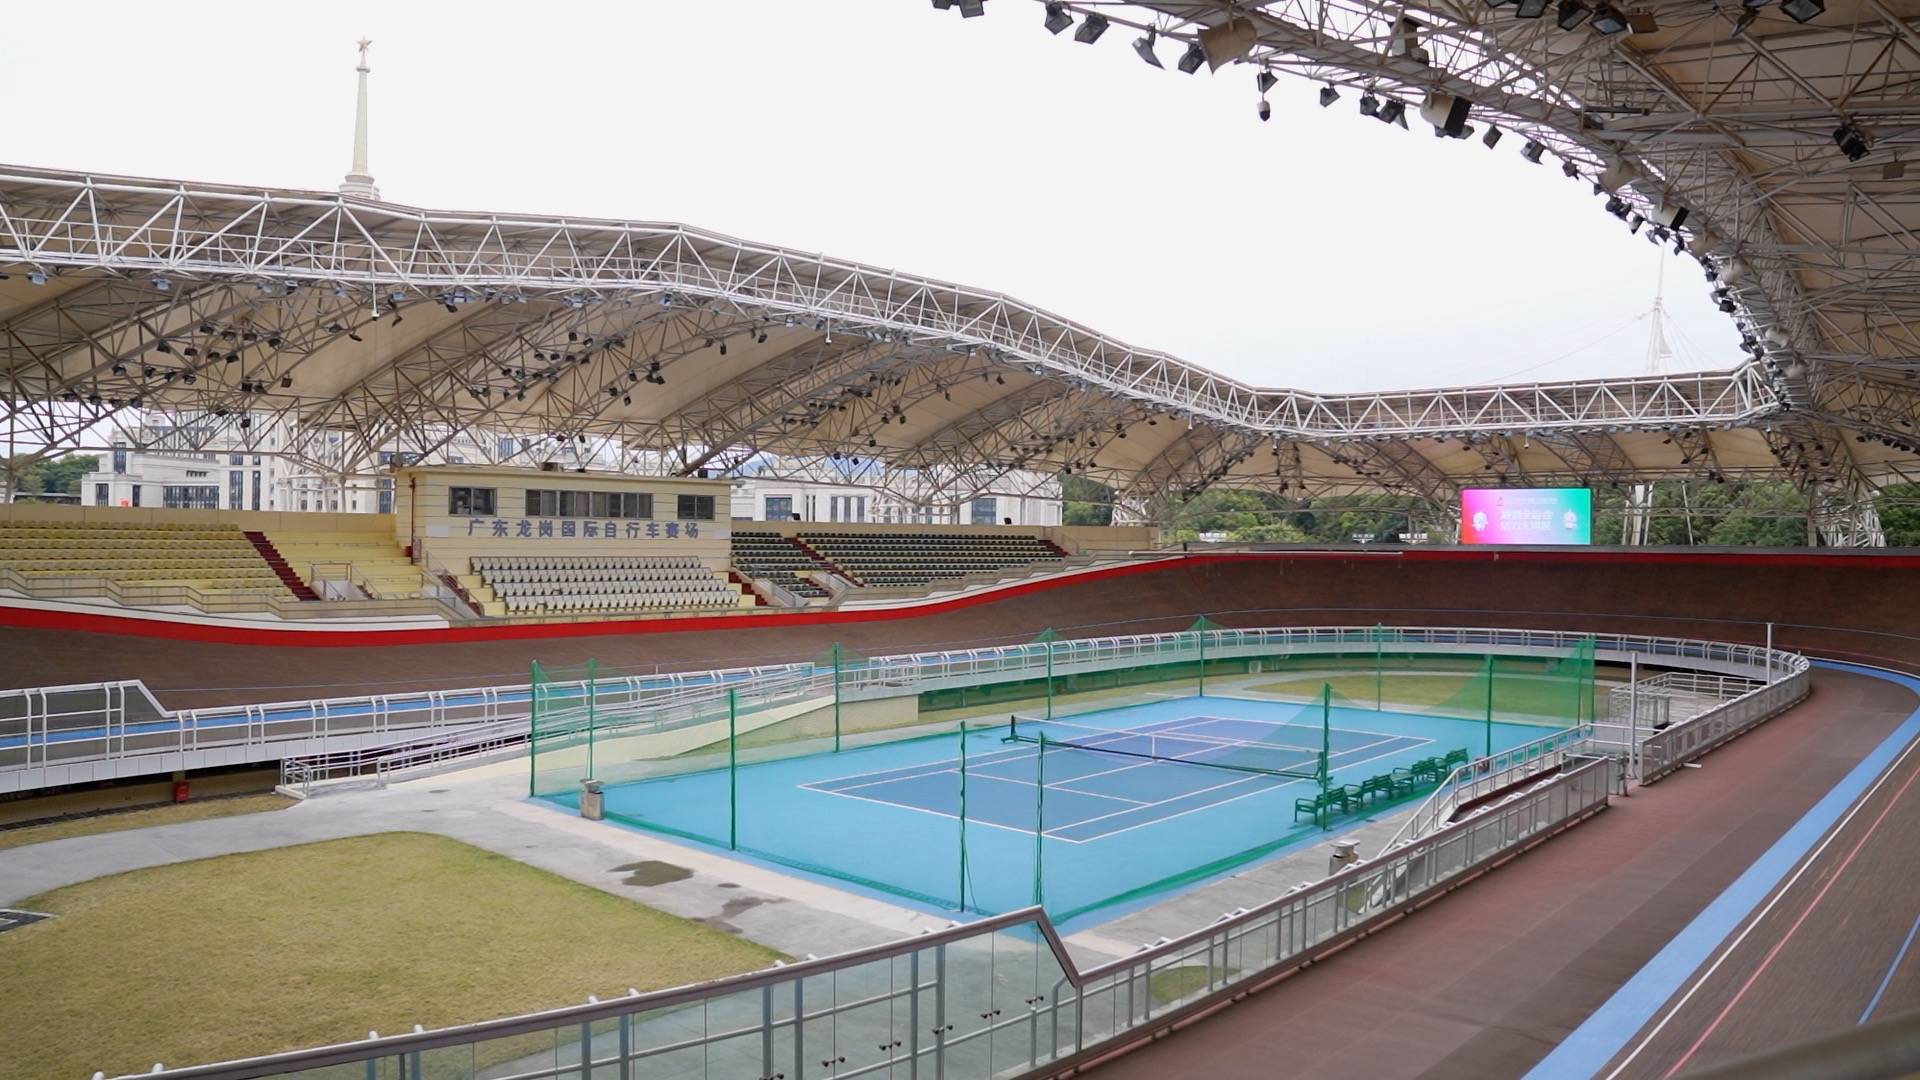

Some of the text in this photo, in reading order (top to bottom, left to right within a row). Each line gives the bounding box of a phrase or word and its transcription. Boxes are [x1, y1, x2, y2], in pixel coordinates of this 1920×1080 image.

[468, 519, 699, 539] 广东龙岗国际自行车赛场
